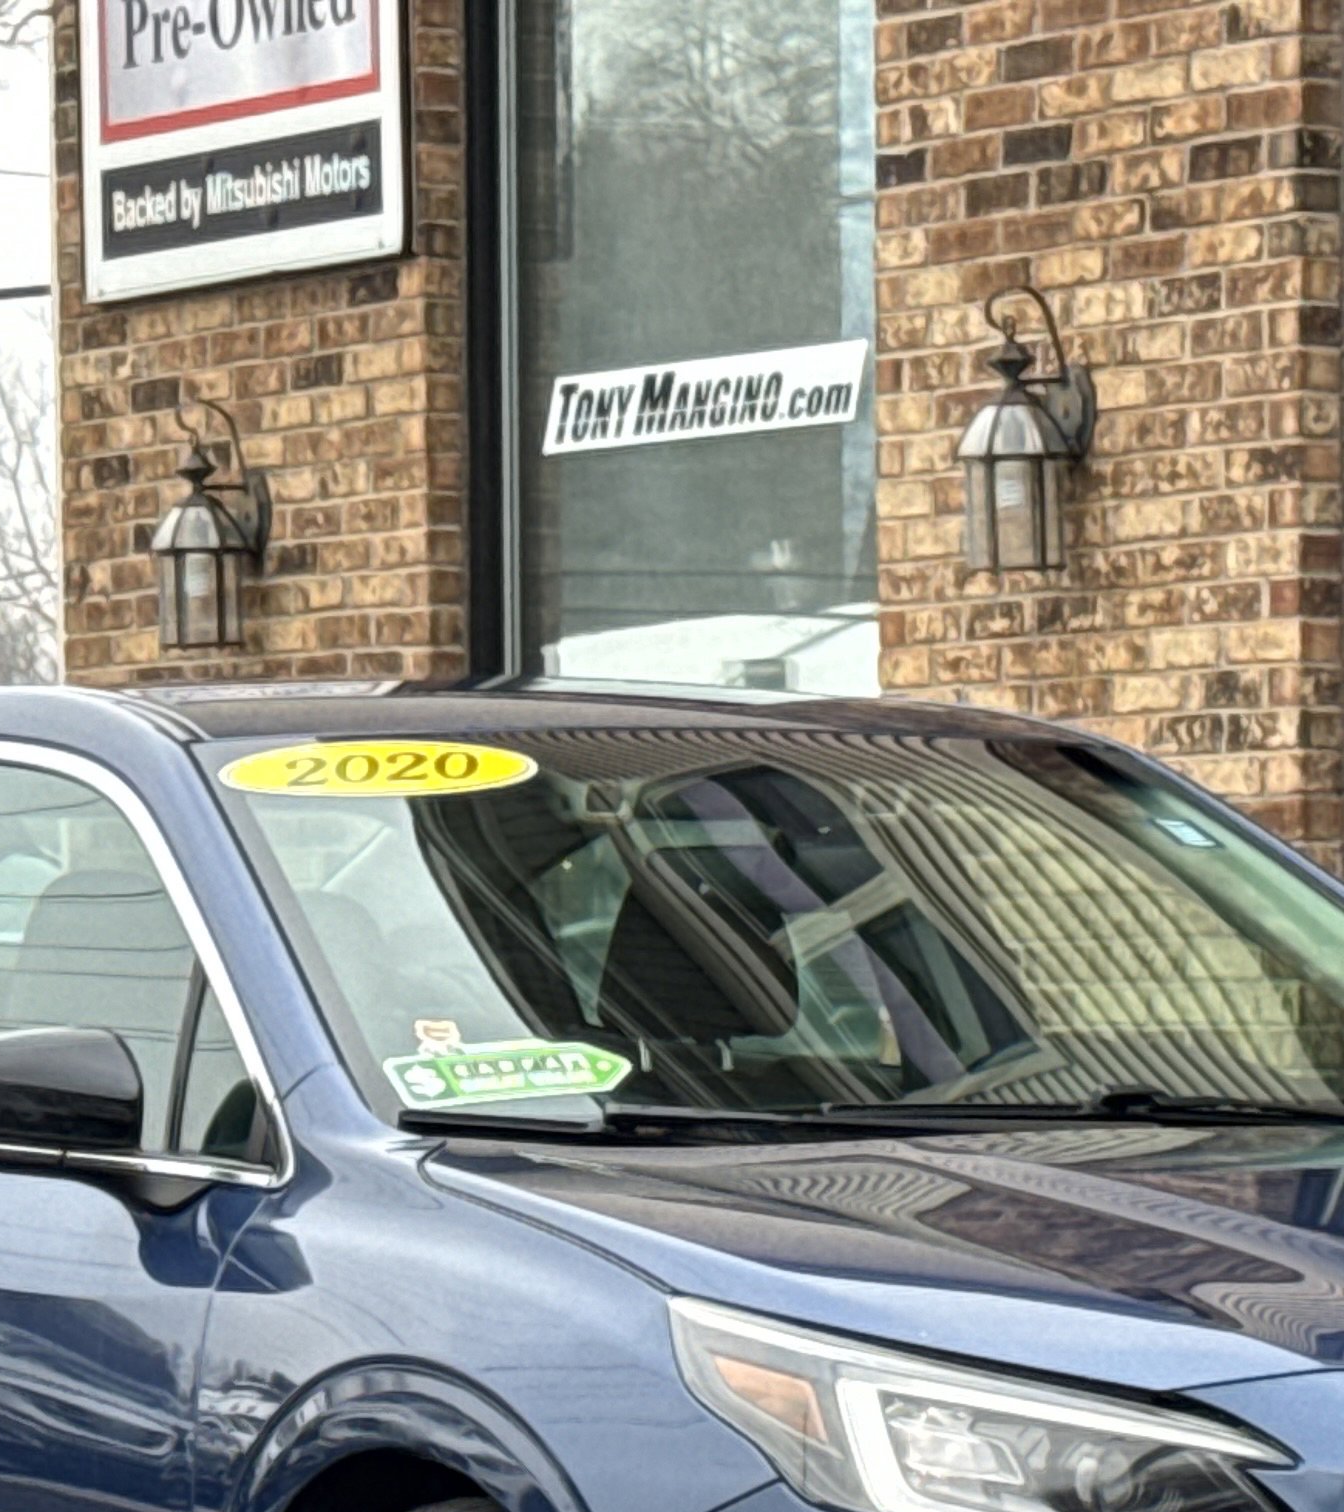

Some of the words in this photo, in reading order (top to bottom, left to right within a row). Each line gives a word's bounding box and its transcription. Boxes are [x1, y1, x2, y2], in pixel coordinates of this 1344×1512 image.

[112, 180, 177, 232] Backed
[179, 179, 203, 230] by
[206, 156, 301, 215] Mitsubishi
[304, 152, 371, 198] Motors
[554, 382, 636, 444] TONY
[284, 751, 479, 787] 2020
